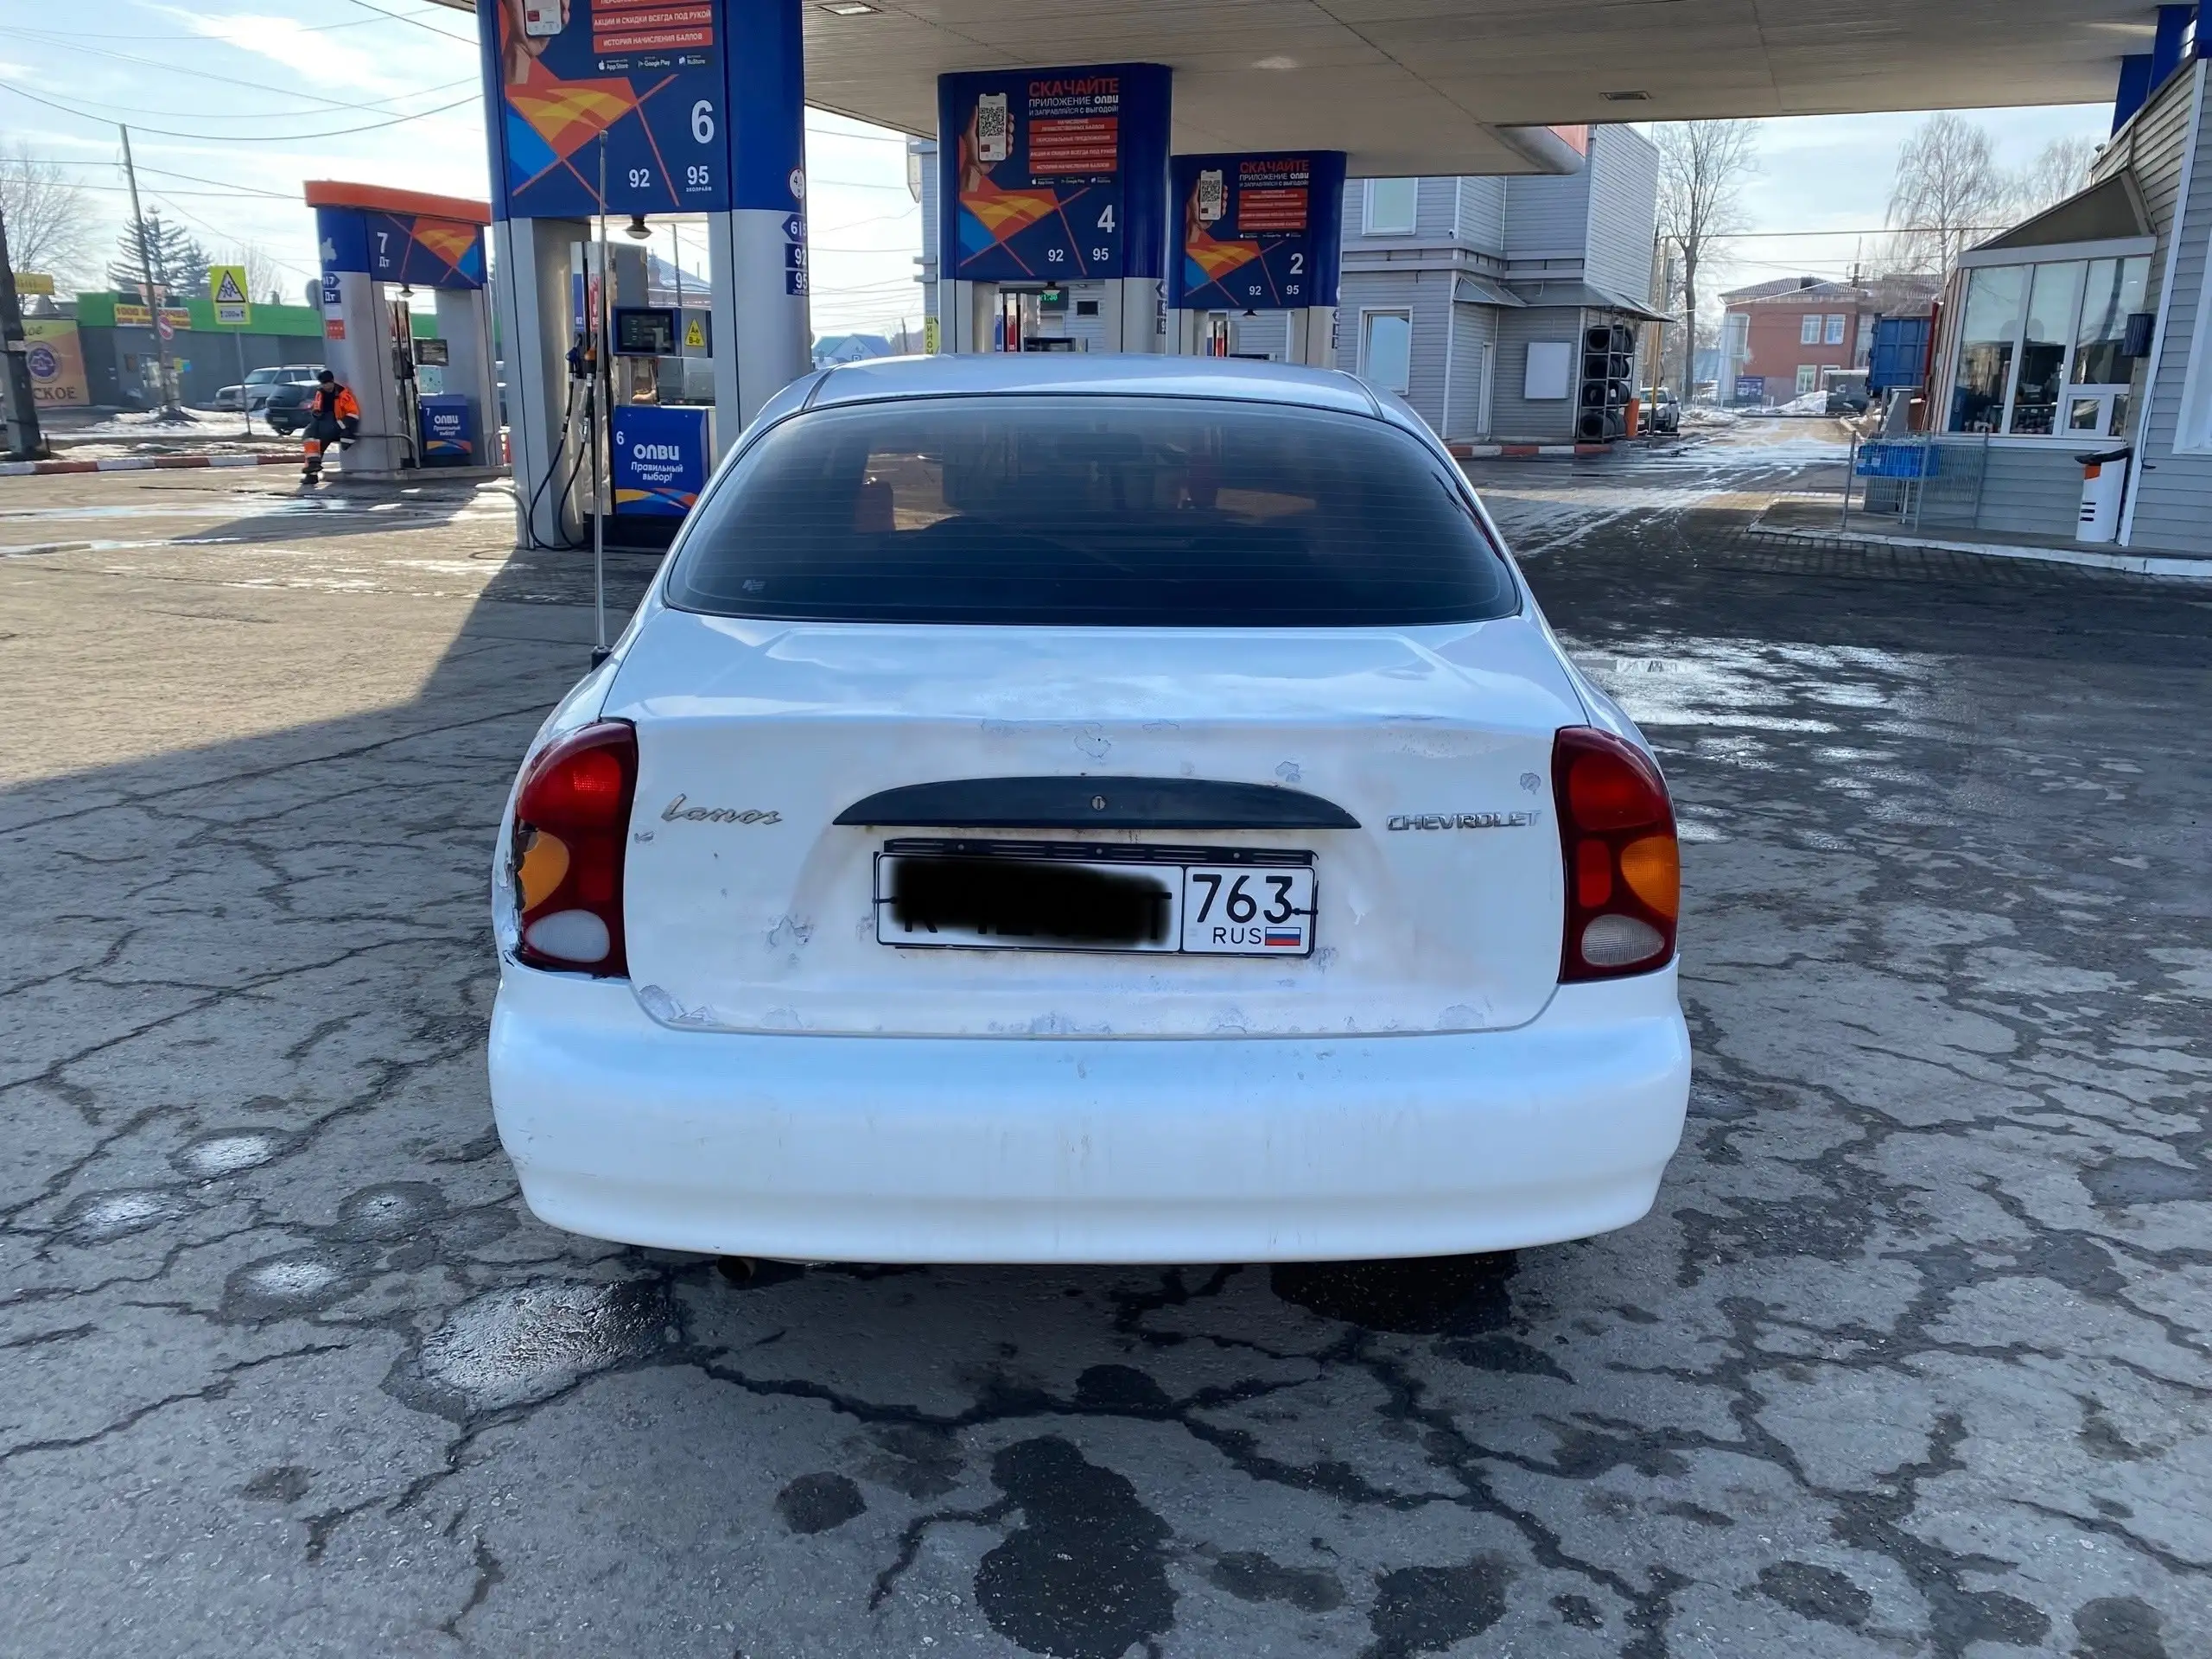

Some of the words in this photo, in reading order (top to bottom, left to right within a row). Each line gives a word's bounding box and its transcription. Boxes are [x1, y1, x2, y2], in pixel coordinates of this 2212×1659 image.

[622, 16, 647, 24] СКИДКИ
[648, 14, 673, 22] ВСЕГДА
[690, 9, 711, 19] РУКОЙ
[603, 37, 632, 46] ИСТОРИЯ
[632, 35, 676, 44] НАЧИСЛЕНИЯ
[677, 33, 703, 41] БАЛЛОВ
[1028, 76, 1120, 97] СКАЧАЙТЕ
[1028, 96, 1091, 107] ПРИЛОЖЕНИЕ
[1094, 95, 1119, 104] ОЛВИ
[691, 99, 715, 144] 6
[1239, 158, 1310, 173] СКАЧАЙТЕ
[628, 168, 650, 188] 92
[687, 166, 709, 185] 95
[1097, 204, 1116, 232] 4
[377, 232, 388, 253] 7
[1048, 249, 1064, 262] 92
[1092, 247, 1109, 261] 95
[378, 256, 391, 268] Дт
[1289, 252, 1304, 274] 2
[325, 291, 335, 302] Дт
[1249, 286, 1262, 296] 92
[1286, 284, 1300, 295] 95
[434, 415, 459, 424] ОЛВИ
[616, 430, 624, 445] 6
[633, 443, 679, 461] ОЛВИ
[631, 461, 683, 473] Правильный
[642, 472, 672, 483] выбор!
[661, 792, 783, 825] Lanos
[1386, 810, 1543, 831] CHEVROLET
[1192, 874, 1293, 924] 763
[1212, 926, 1262, 944] RUS
